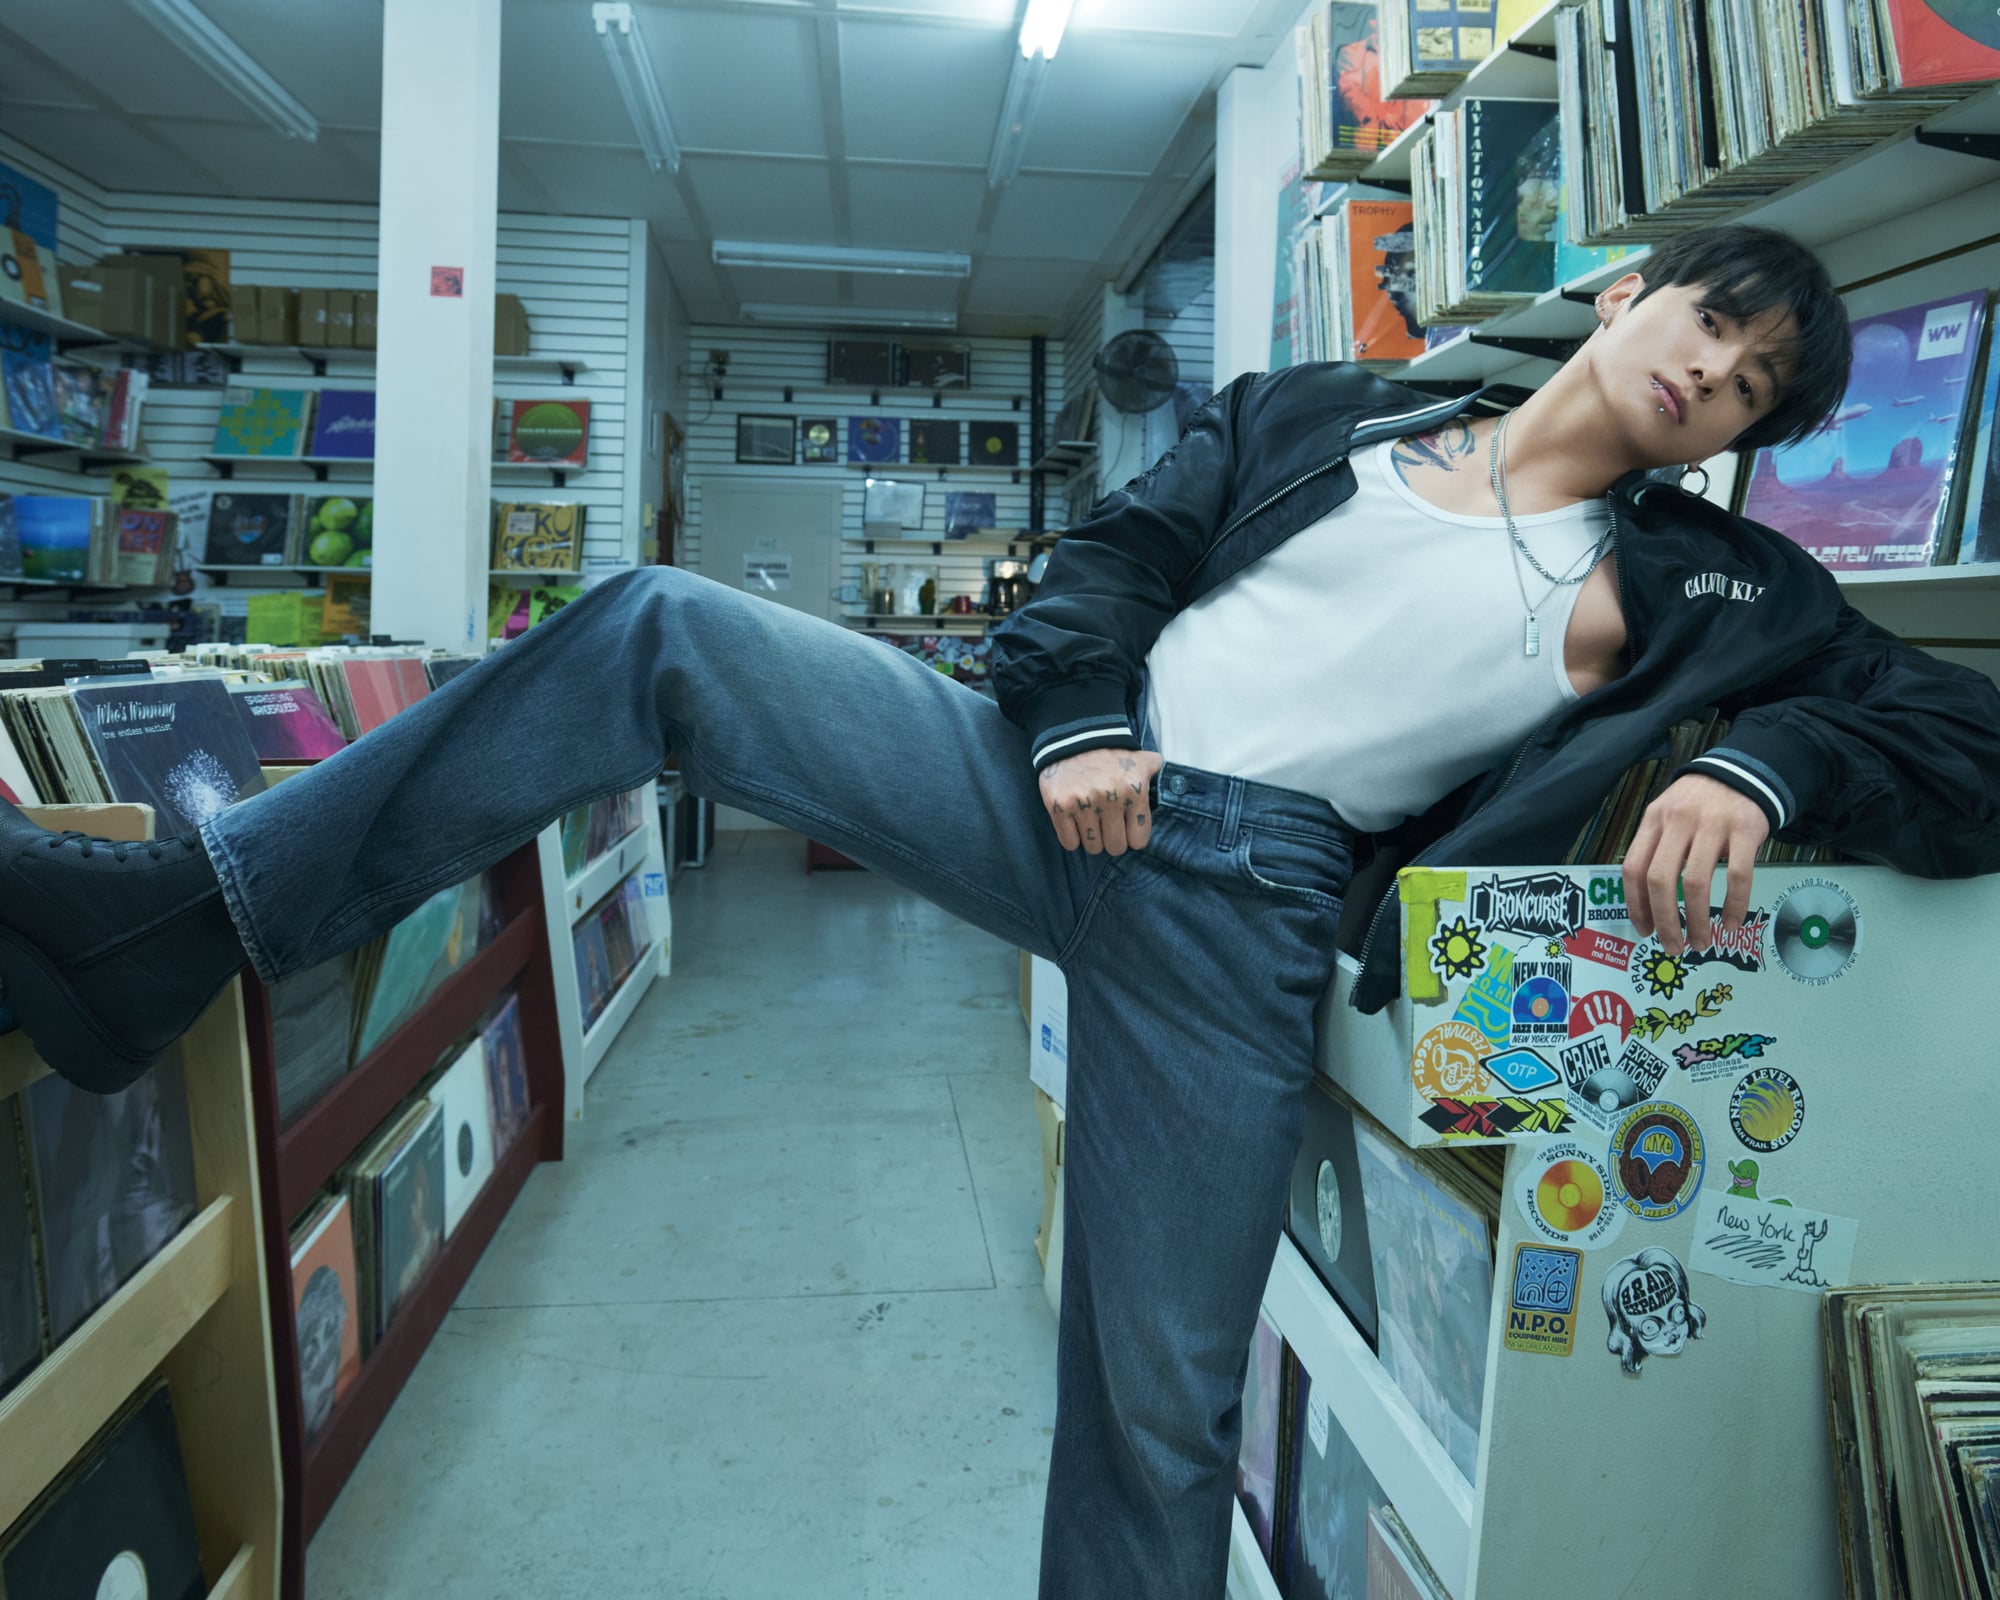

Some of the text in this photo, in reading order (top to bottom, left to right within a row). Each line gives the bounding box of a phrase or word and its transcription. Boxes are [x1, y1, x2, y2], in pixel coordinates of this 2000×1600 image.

[1469, 100, 1483, 286] AVIATION NATION
[1352, 205, 1397, 216] TROPHY
[1928, 322, 1963, 343] WW
[1685, 572, 1729, 599] CALVIN
[96, 700, 176, 725] Who's Winning
[1482, 874, 1576, 938] IRONCURSE
[1591, 950, 1604, 960] me
[1594, 936, 1629, 956] HOLA
[1514, 962, 1569, 994] NEW YORK
[1631, 943, 1649, 994] BRAND
[1436, 1023, 1488, 1051] FESTIVAL
[1512, 1024, 1568, 1033] JAZZ ON MAIN
[1512, 1035, 1568, 1043] NEW YORK CITY
[1506, 1062, 1538, 1078] OTP
[1562, 1038, 1612, 1084] CRATE
[1625, 1041, 1670, 1078] EXPECT
[1690, 1058, 1742, 1072] RECORDINGS
[1616, 1057, 1659, 1094] ATIONS
[1730, 1069, 1803, 1150] NEXT LEVEL RECORDS
[1659, 1103, 1702, 1160] CONNECTOR
[1733, 1120, 1747, 1141] SAN
[1547, 1143, 1576, 1154] BLEEKER
[1644, 1133, 1673, 1154] NYC
[1546, 1149, 1597, 1163] SONNY
[1596, 1164, 1612, 1202] SIDE
[1527, 1188, 1569, 1241] RECORDS
[1596, 1205, 1610, 1226] UP
[1644, 1203, 1677, 1218] HIRE
[1757, 1213, 1796, 1242] York
[1621, 1270, 1674, 1306] BRAIN
[1510, 1311, 1569, 1335] N.P.O.
[1508, 1332, 1568, 1344] EQUIPMENT HIRE
